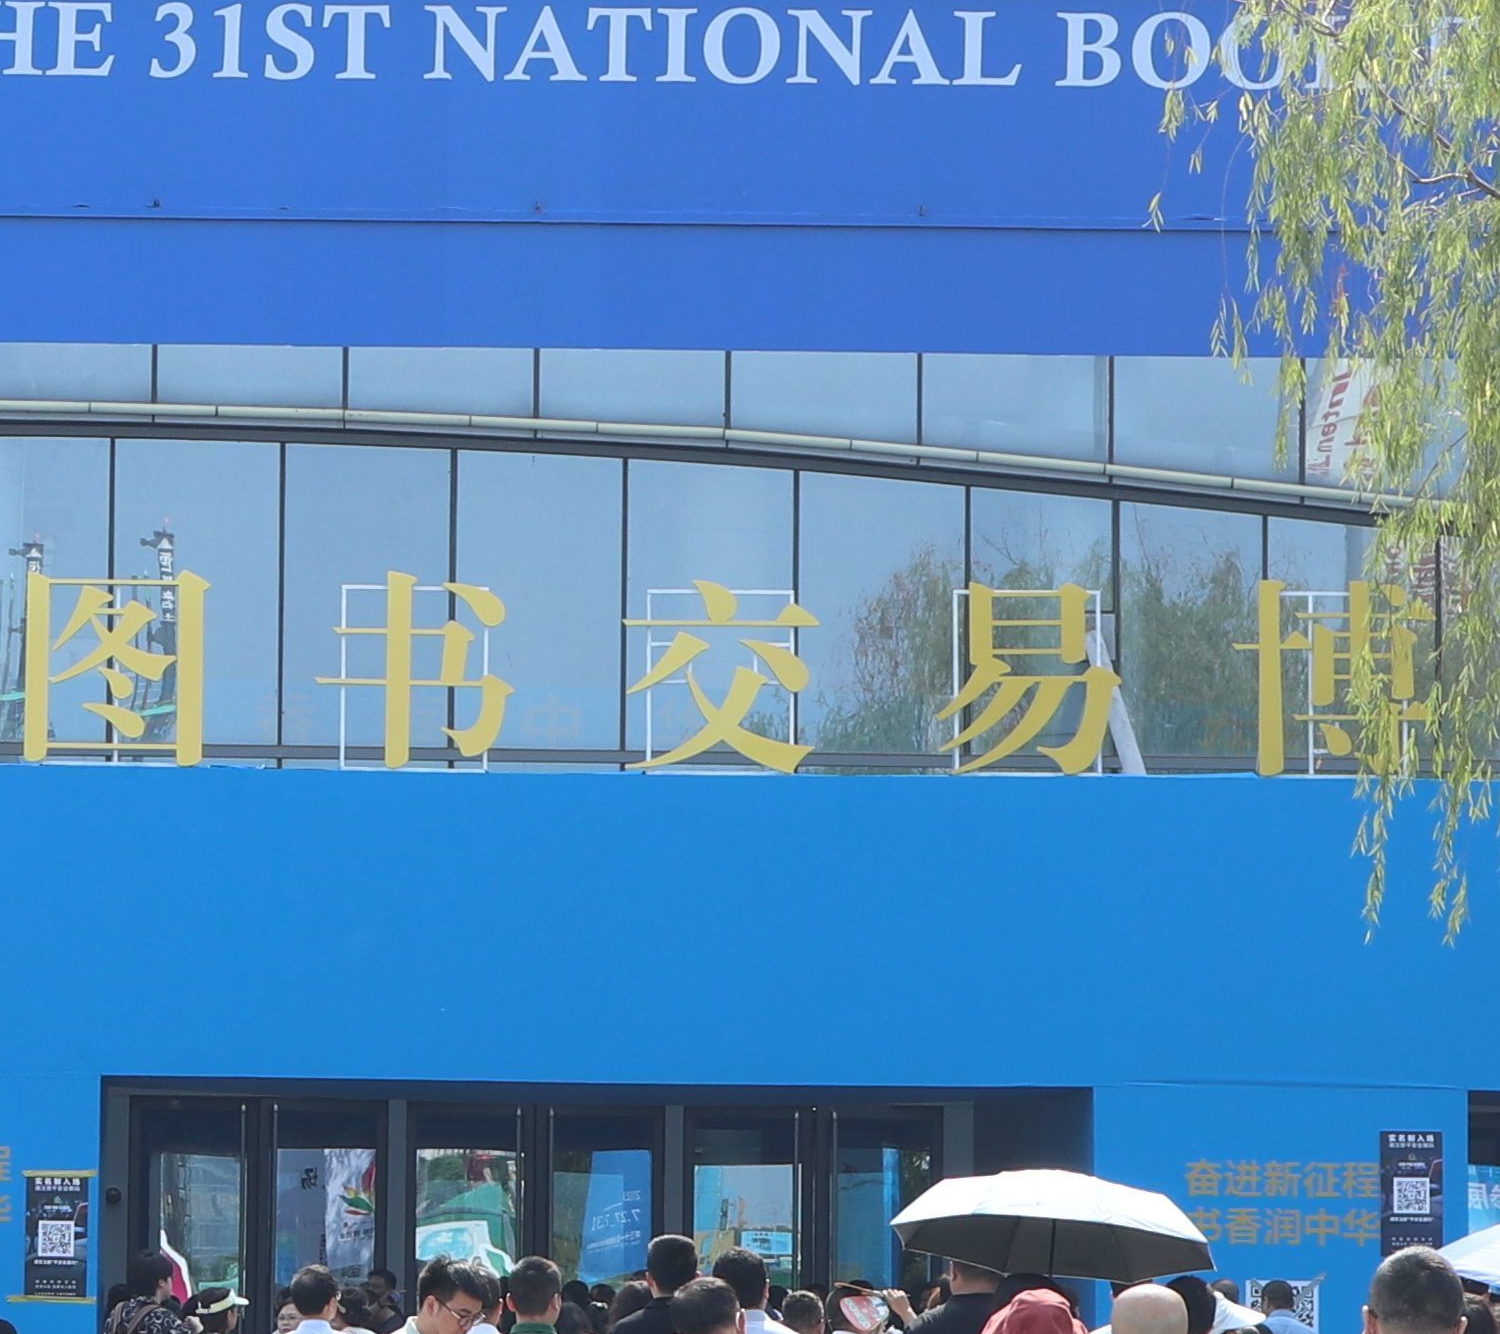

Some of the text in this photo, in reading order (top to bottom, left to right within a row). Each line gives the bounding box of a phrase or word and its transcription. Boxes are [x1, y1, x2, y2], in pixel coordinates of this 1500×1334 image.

[149, 1, 390, 81] 31ST
[423, 5, 1023, 88] NATIONAL
[1185, 1158, 1381, 1199] 奋进新征程
[1190, 1205, 1381, 1248] 书香润中华
